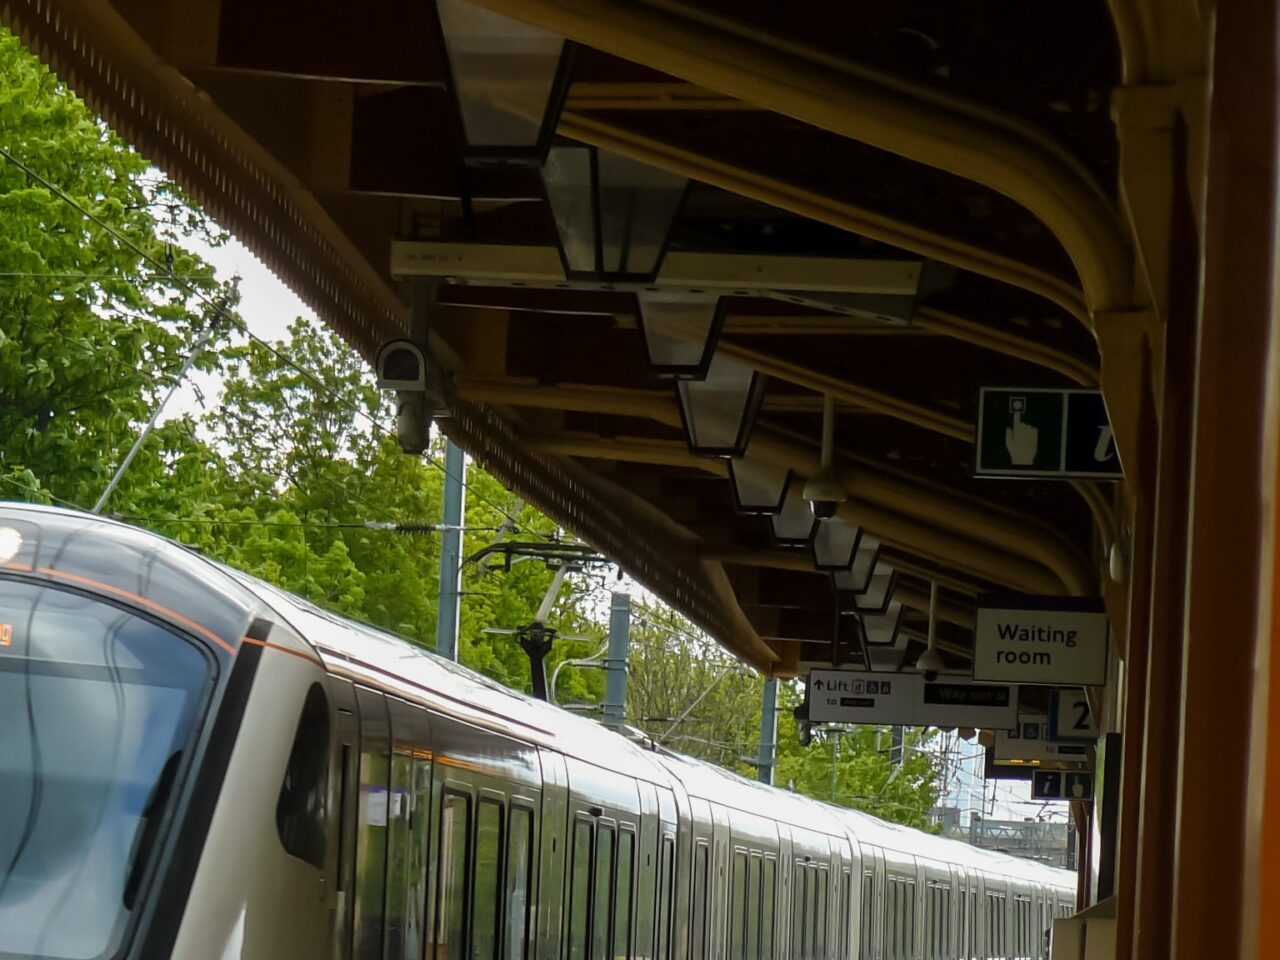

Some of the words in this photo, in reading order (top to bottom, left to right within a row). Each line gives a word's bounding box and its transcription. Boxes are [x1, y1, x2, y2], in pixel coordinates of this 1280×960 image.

[997, 623, 1078, 647] Waiting
[996, 651, 1051, 665] room
[826, 679, 849, 692] Lift
[826, 696, 837, 706] to
[1072, 701, 1090, 730] 2
